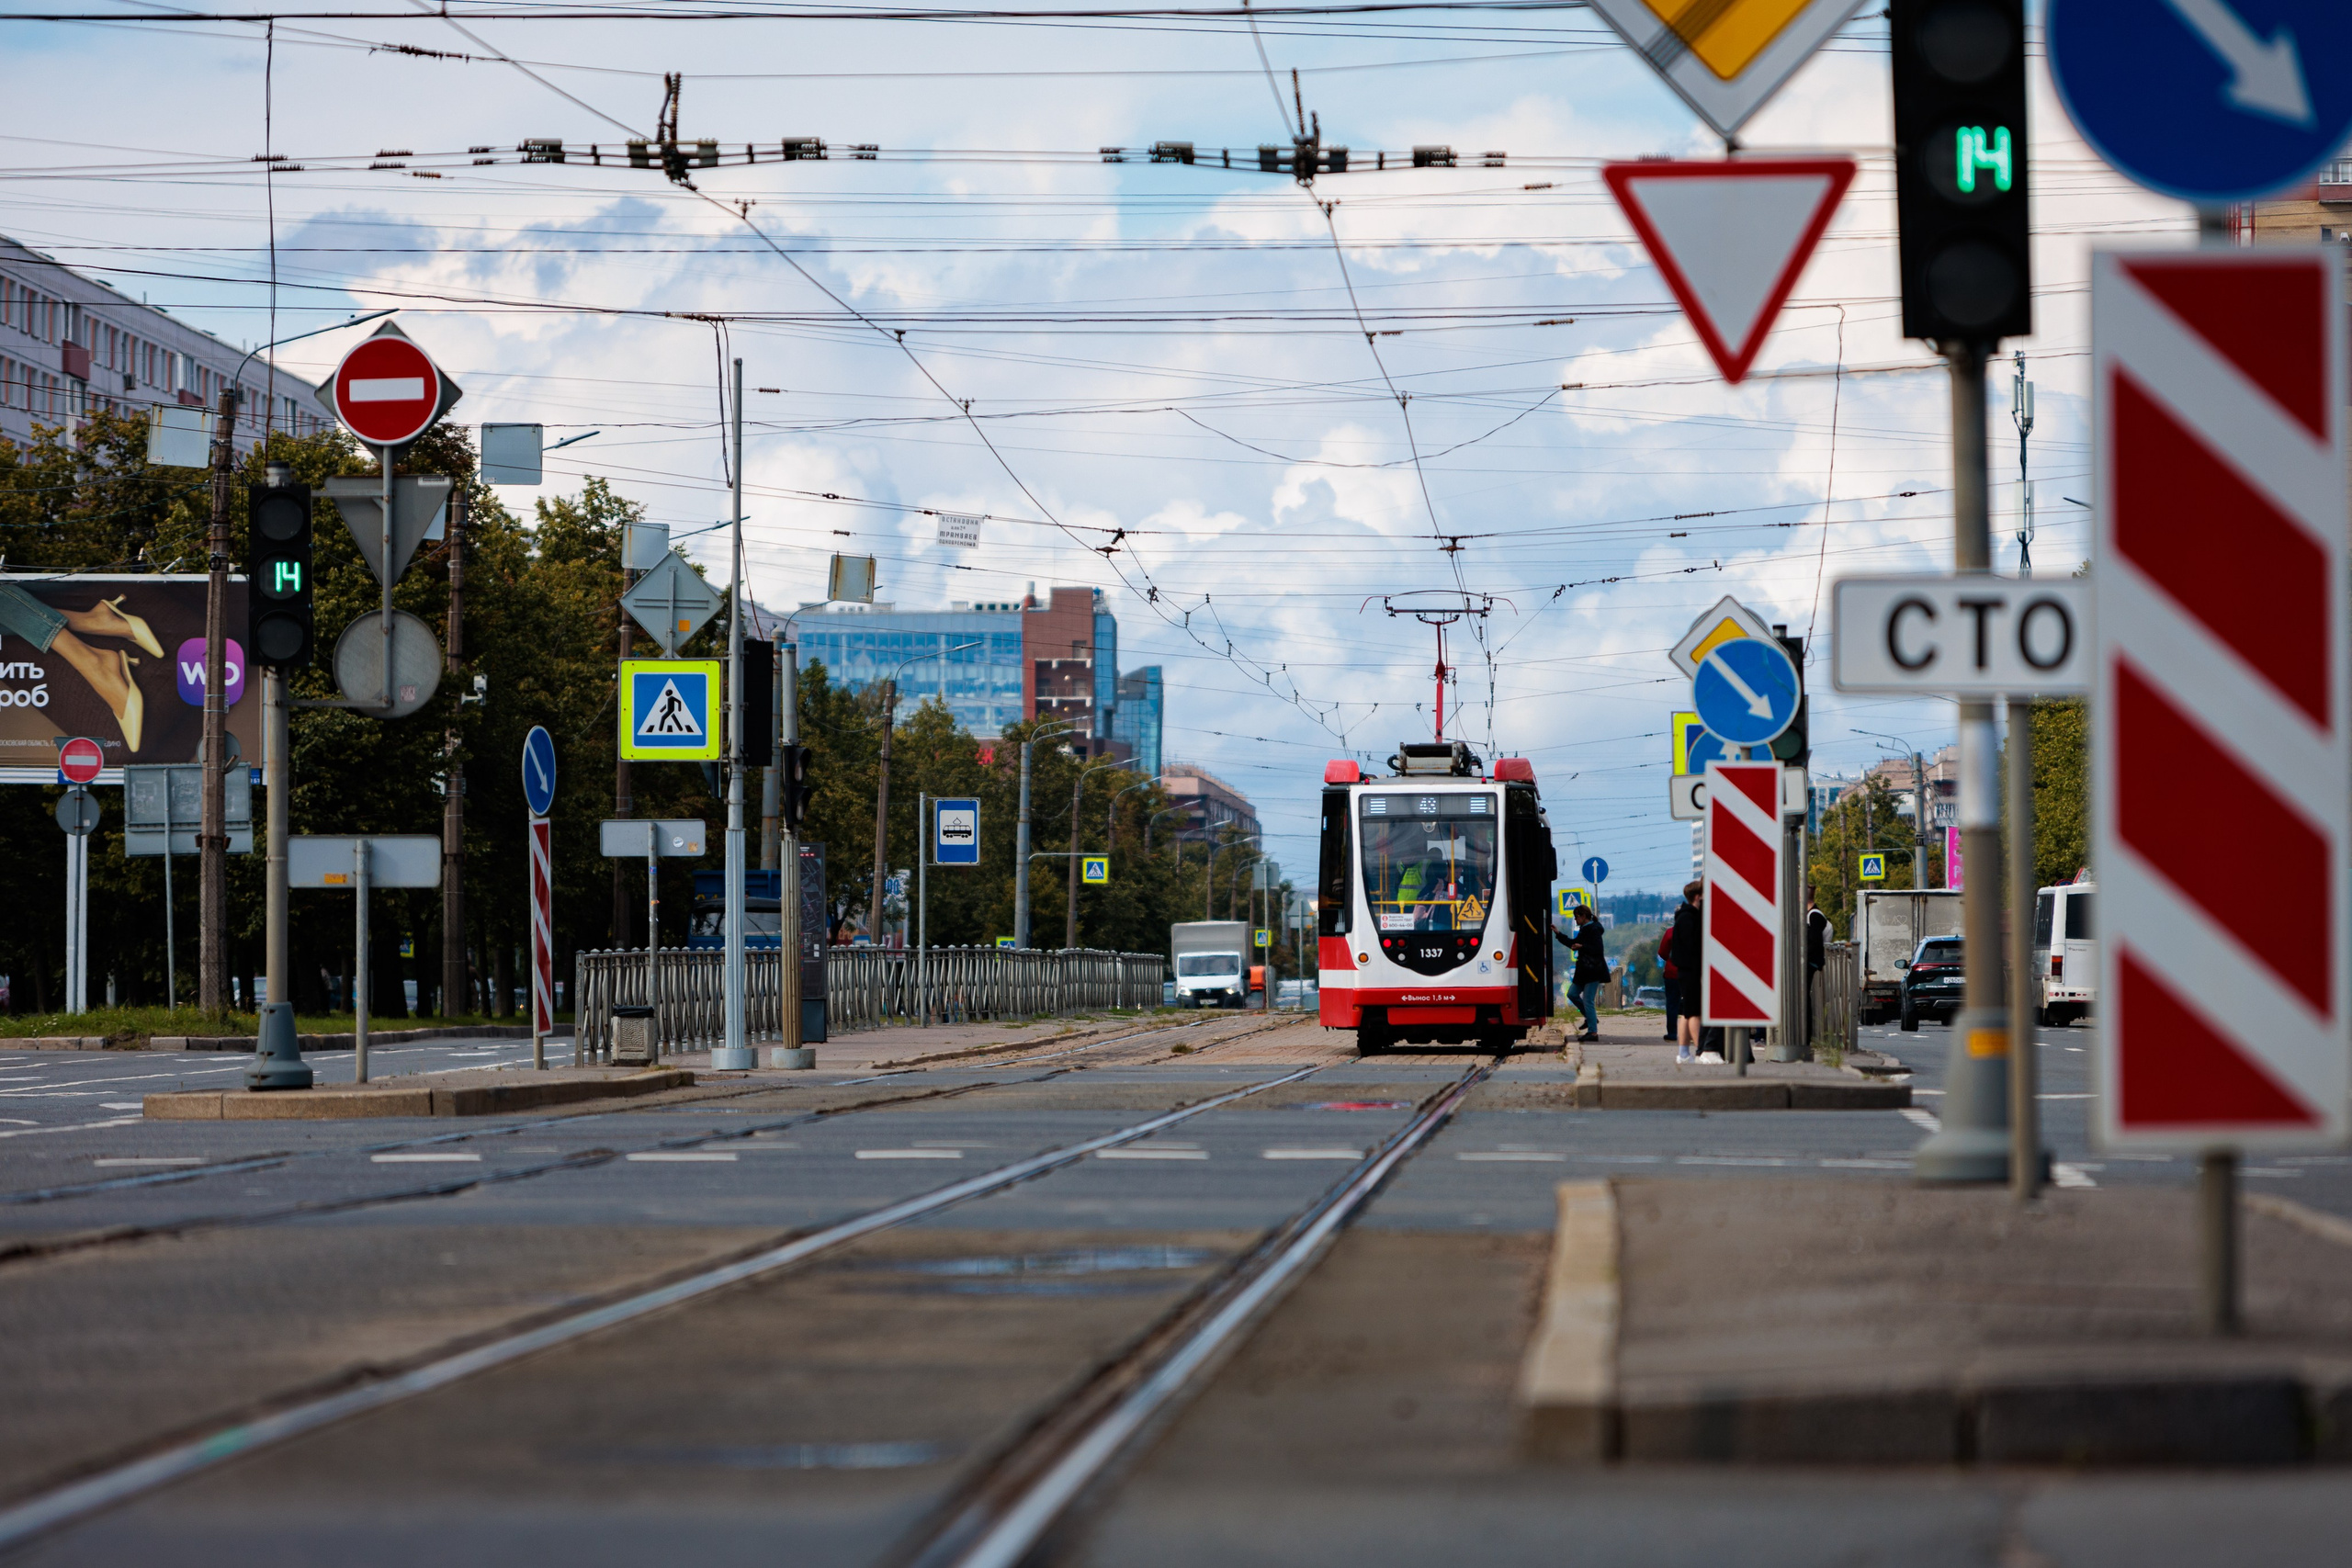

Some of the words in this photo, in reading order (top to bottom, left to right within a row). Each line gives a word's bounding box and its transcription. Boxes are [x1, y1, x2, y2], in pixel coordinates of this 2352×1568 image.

[1956, 127, 2012, 193] 14
[941, 516, 978, 525] ОСТАНОВКА
[275, 560, 300, 592] 14
[1419, 798, 1436, 813] 43
[1419, 948, 1443, 958] 1337
